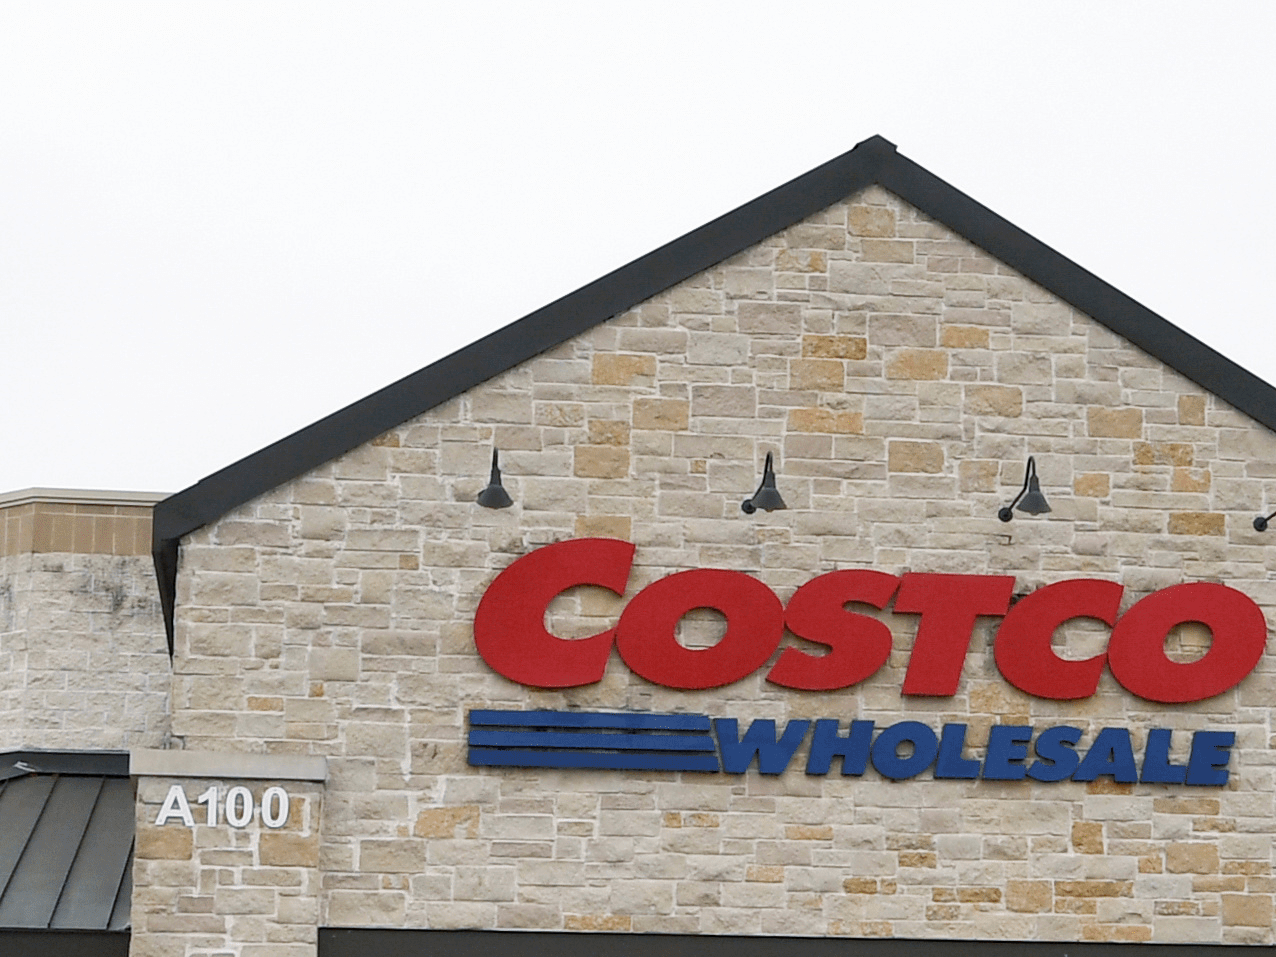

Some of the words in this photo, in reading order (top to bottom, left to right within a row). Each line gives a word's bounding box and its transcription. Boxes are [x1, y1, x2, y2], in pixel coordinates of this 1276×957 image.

[473, 536, 1267, 704] COSTCO
[714, 717, 1236, 786] WHOLESALE
[155, 785, 290, 828] A100
